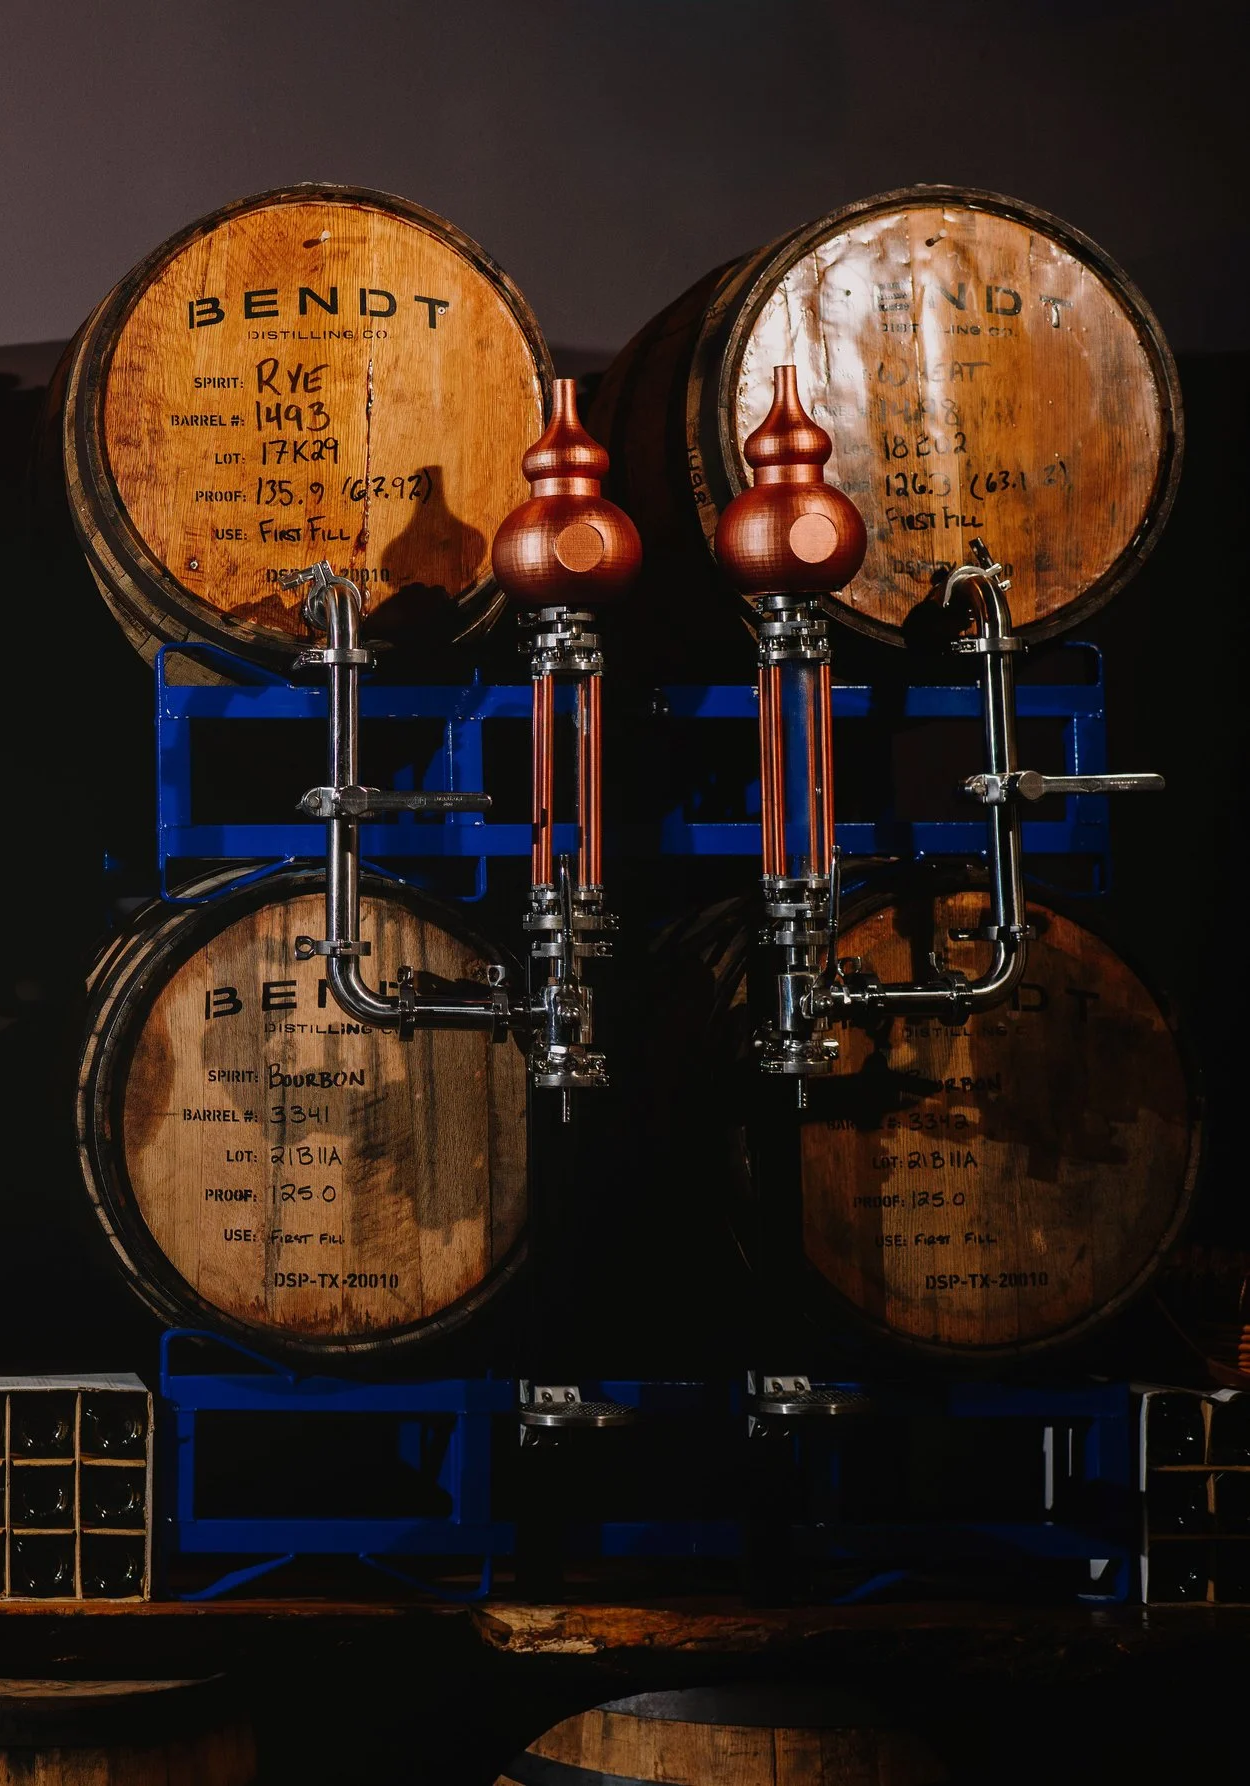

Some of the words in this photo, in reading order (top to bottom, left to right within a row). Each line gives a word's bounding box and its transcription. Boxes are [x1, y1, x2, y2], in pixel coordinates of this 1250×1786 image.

[188, 287, 449, 329] BENDT
[248, 329, 354, 340] DISTILLING
[194, 377, 243, 389] SPIRIT:
[256, 358, 329, 394] RYE
[170, 415, 226, 427] BARREL
[255, 401, 330, 431] 1493
[215, 453, 246, 464] LOT:
[262, 438, 338, 465] 17K29
[196, 491, 246, 502] PROOF:
[215, 529, 247, 540] USE:
[264, 1023, 372, 1035] DISTILLING
[208, 1070, 258, 1082] SPIRIT:
[268, 1064, 365, 1090] BOURBON
[183, 1109, 240, 1122] BARREL
[270, 1106, 328, 1124] 3341
[226, 1150, 257, 1163] LOT:
[873, 1155, 903, 1170] LOT:
[205, 1188, 257, 1202] PROOF:
[272, 1184, 336, 1202] 125.0
[854, 1196, 904, 1209] PROOF:
[224, 1228, 256, 1241] USE:
[875, 1235, 907, 1247] USE:
[274, 1272, 399, 1289] DSP-TX-20010
[926, 1271, 1048, 1289] DSP-TX-20010
